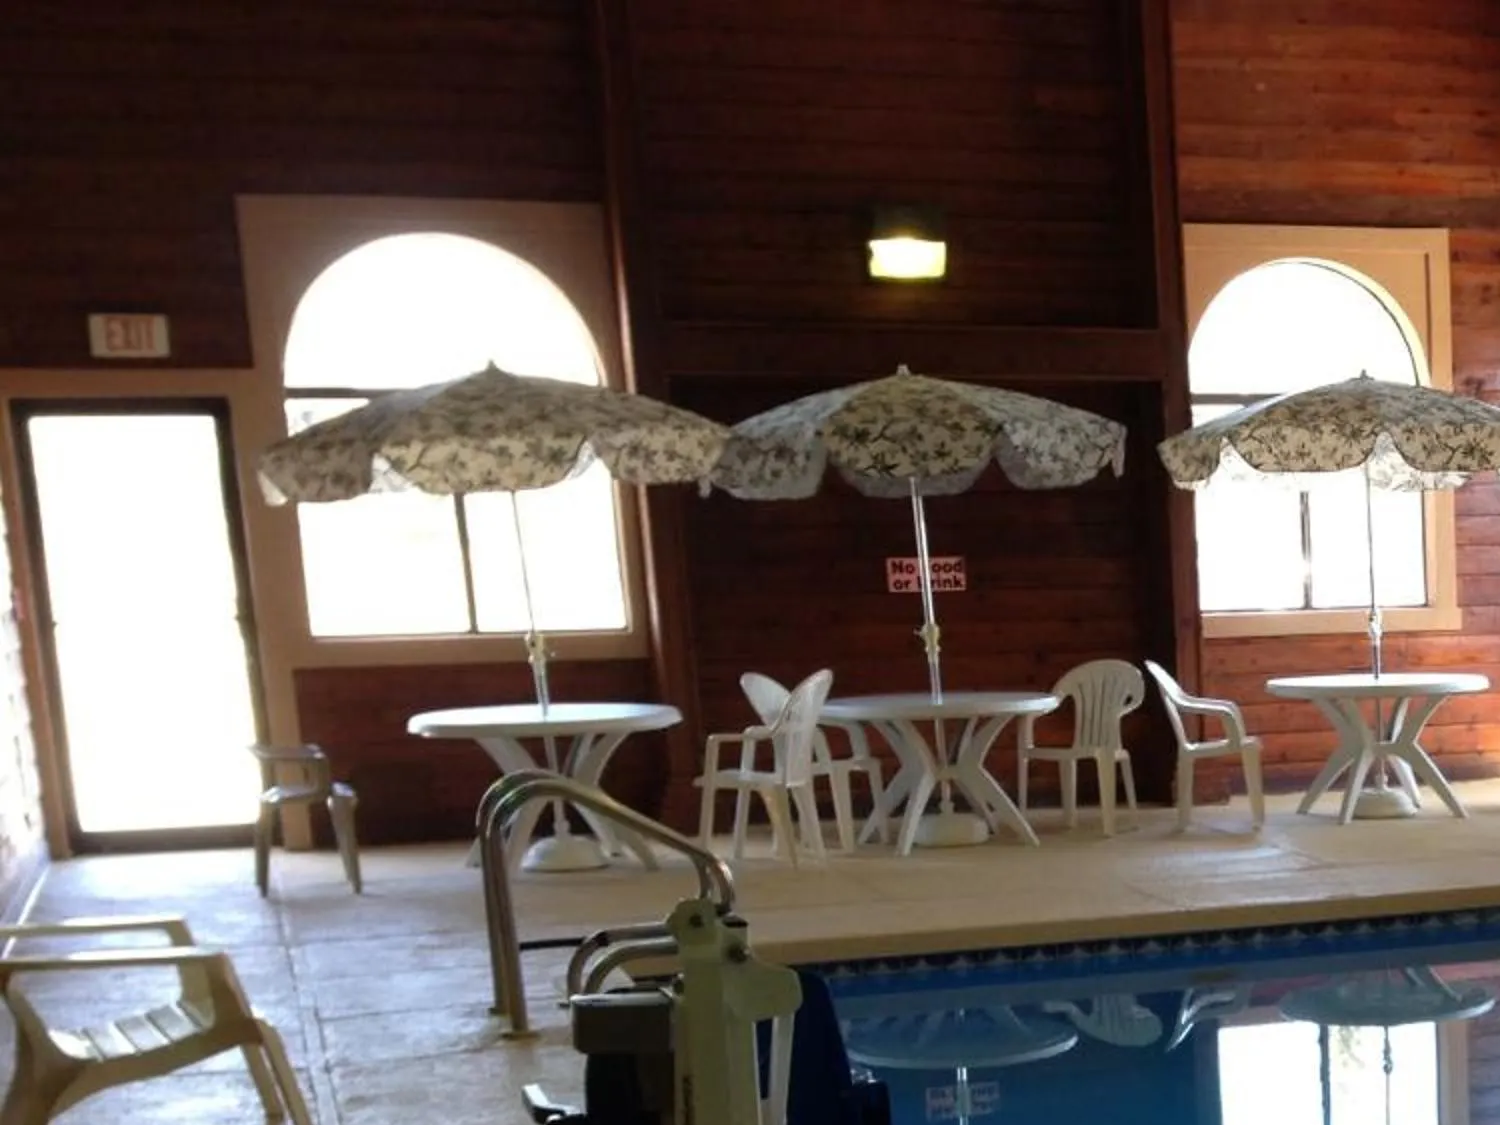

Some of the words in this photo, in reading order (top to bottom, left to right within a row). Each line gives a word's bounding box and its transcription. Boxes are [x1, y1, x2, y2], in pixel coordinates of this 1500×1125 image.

[891, 560, 915, 574] No
[931, 560, 963, 574] ood
[893, 579, 912, 590] or
